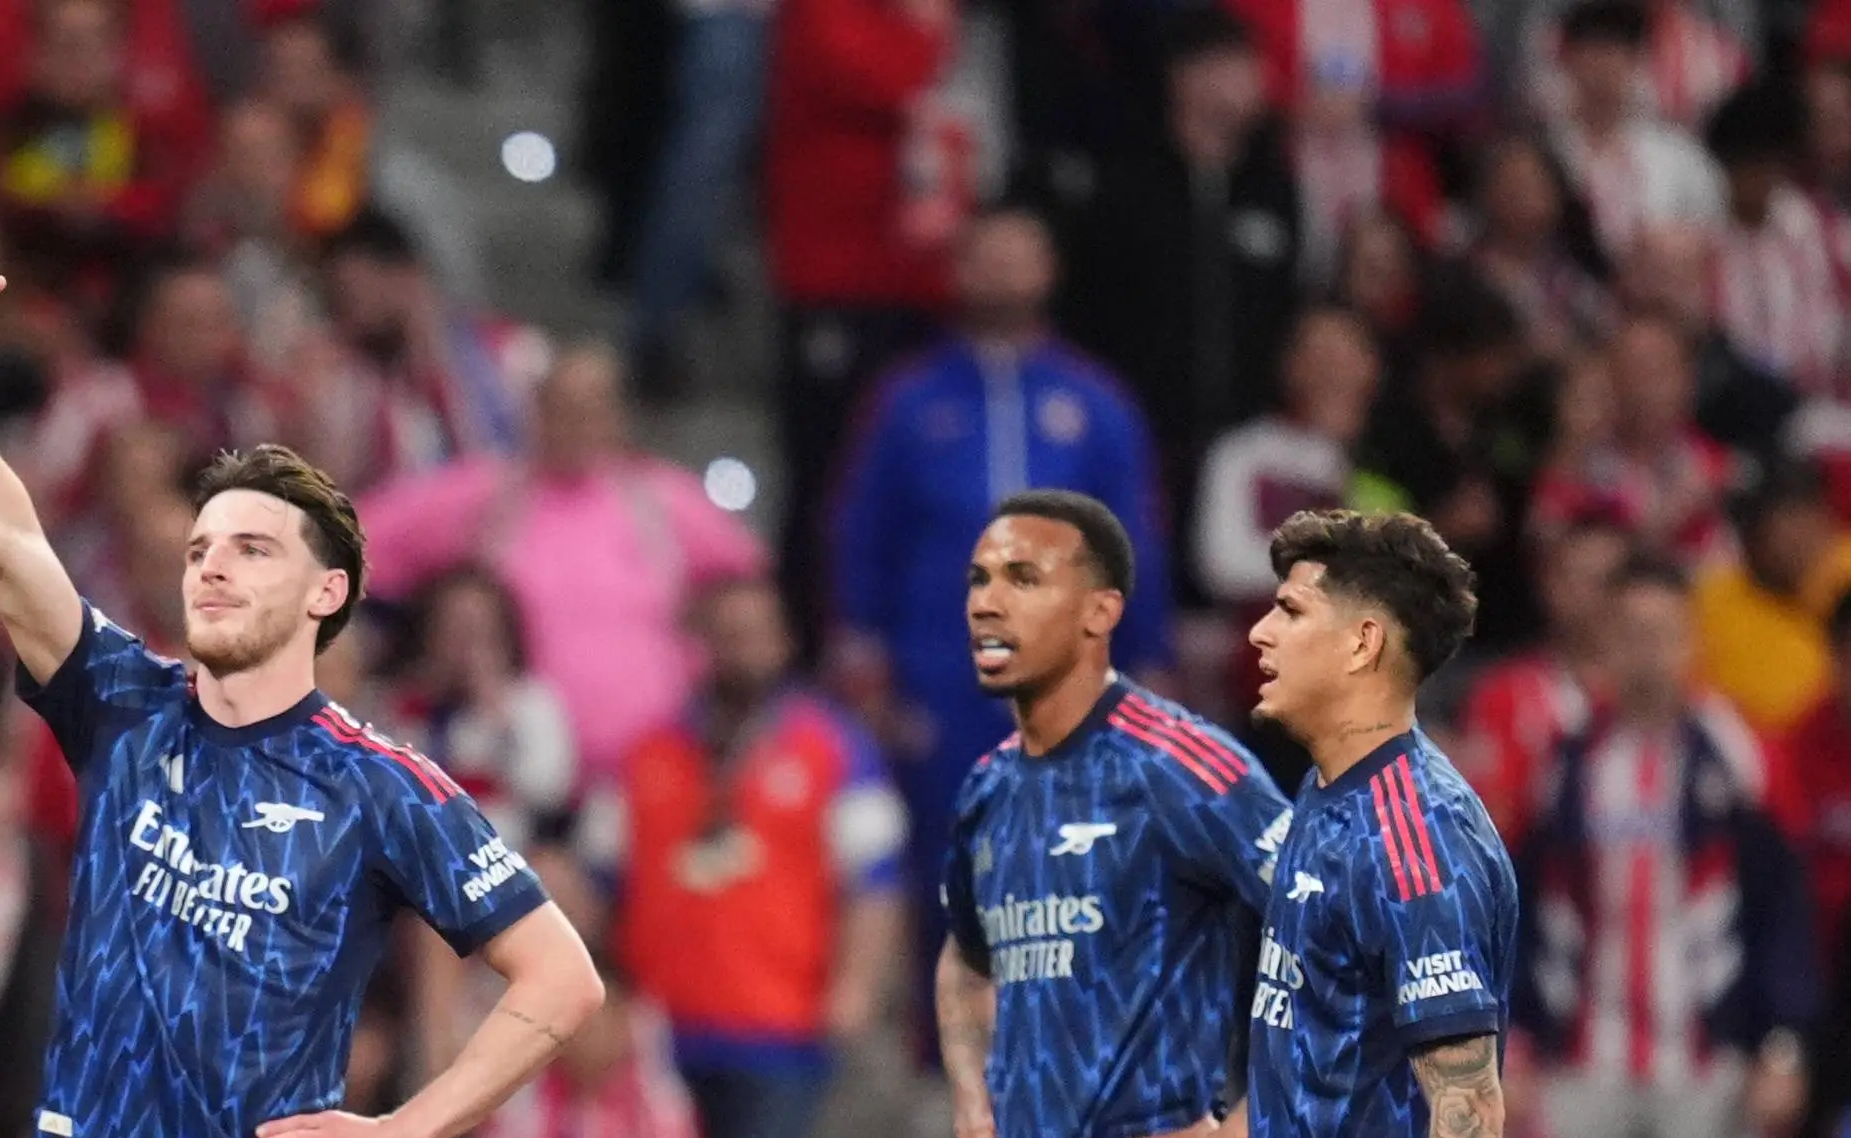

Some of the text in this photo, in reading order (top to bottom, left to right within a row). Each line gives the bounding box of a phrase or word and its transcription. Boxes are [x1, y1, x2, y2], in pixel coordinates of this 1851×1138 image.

[468, 837, 508, 870] VIS
[462, 851, 527, 902] RWAN
[978, 892, 1105, 945] mirates
[1406, 949, 1462, 980] VISIT
